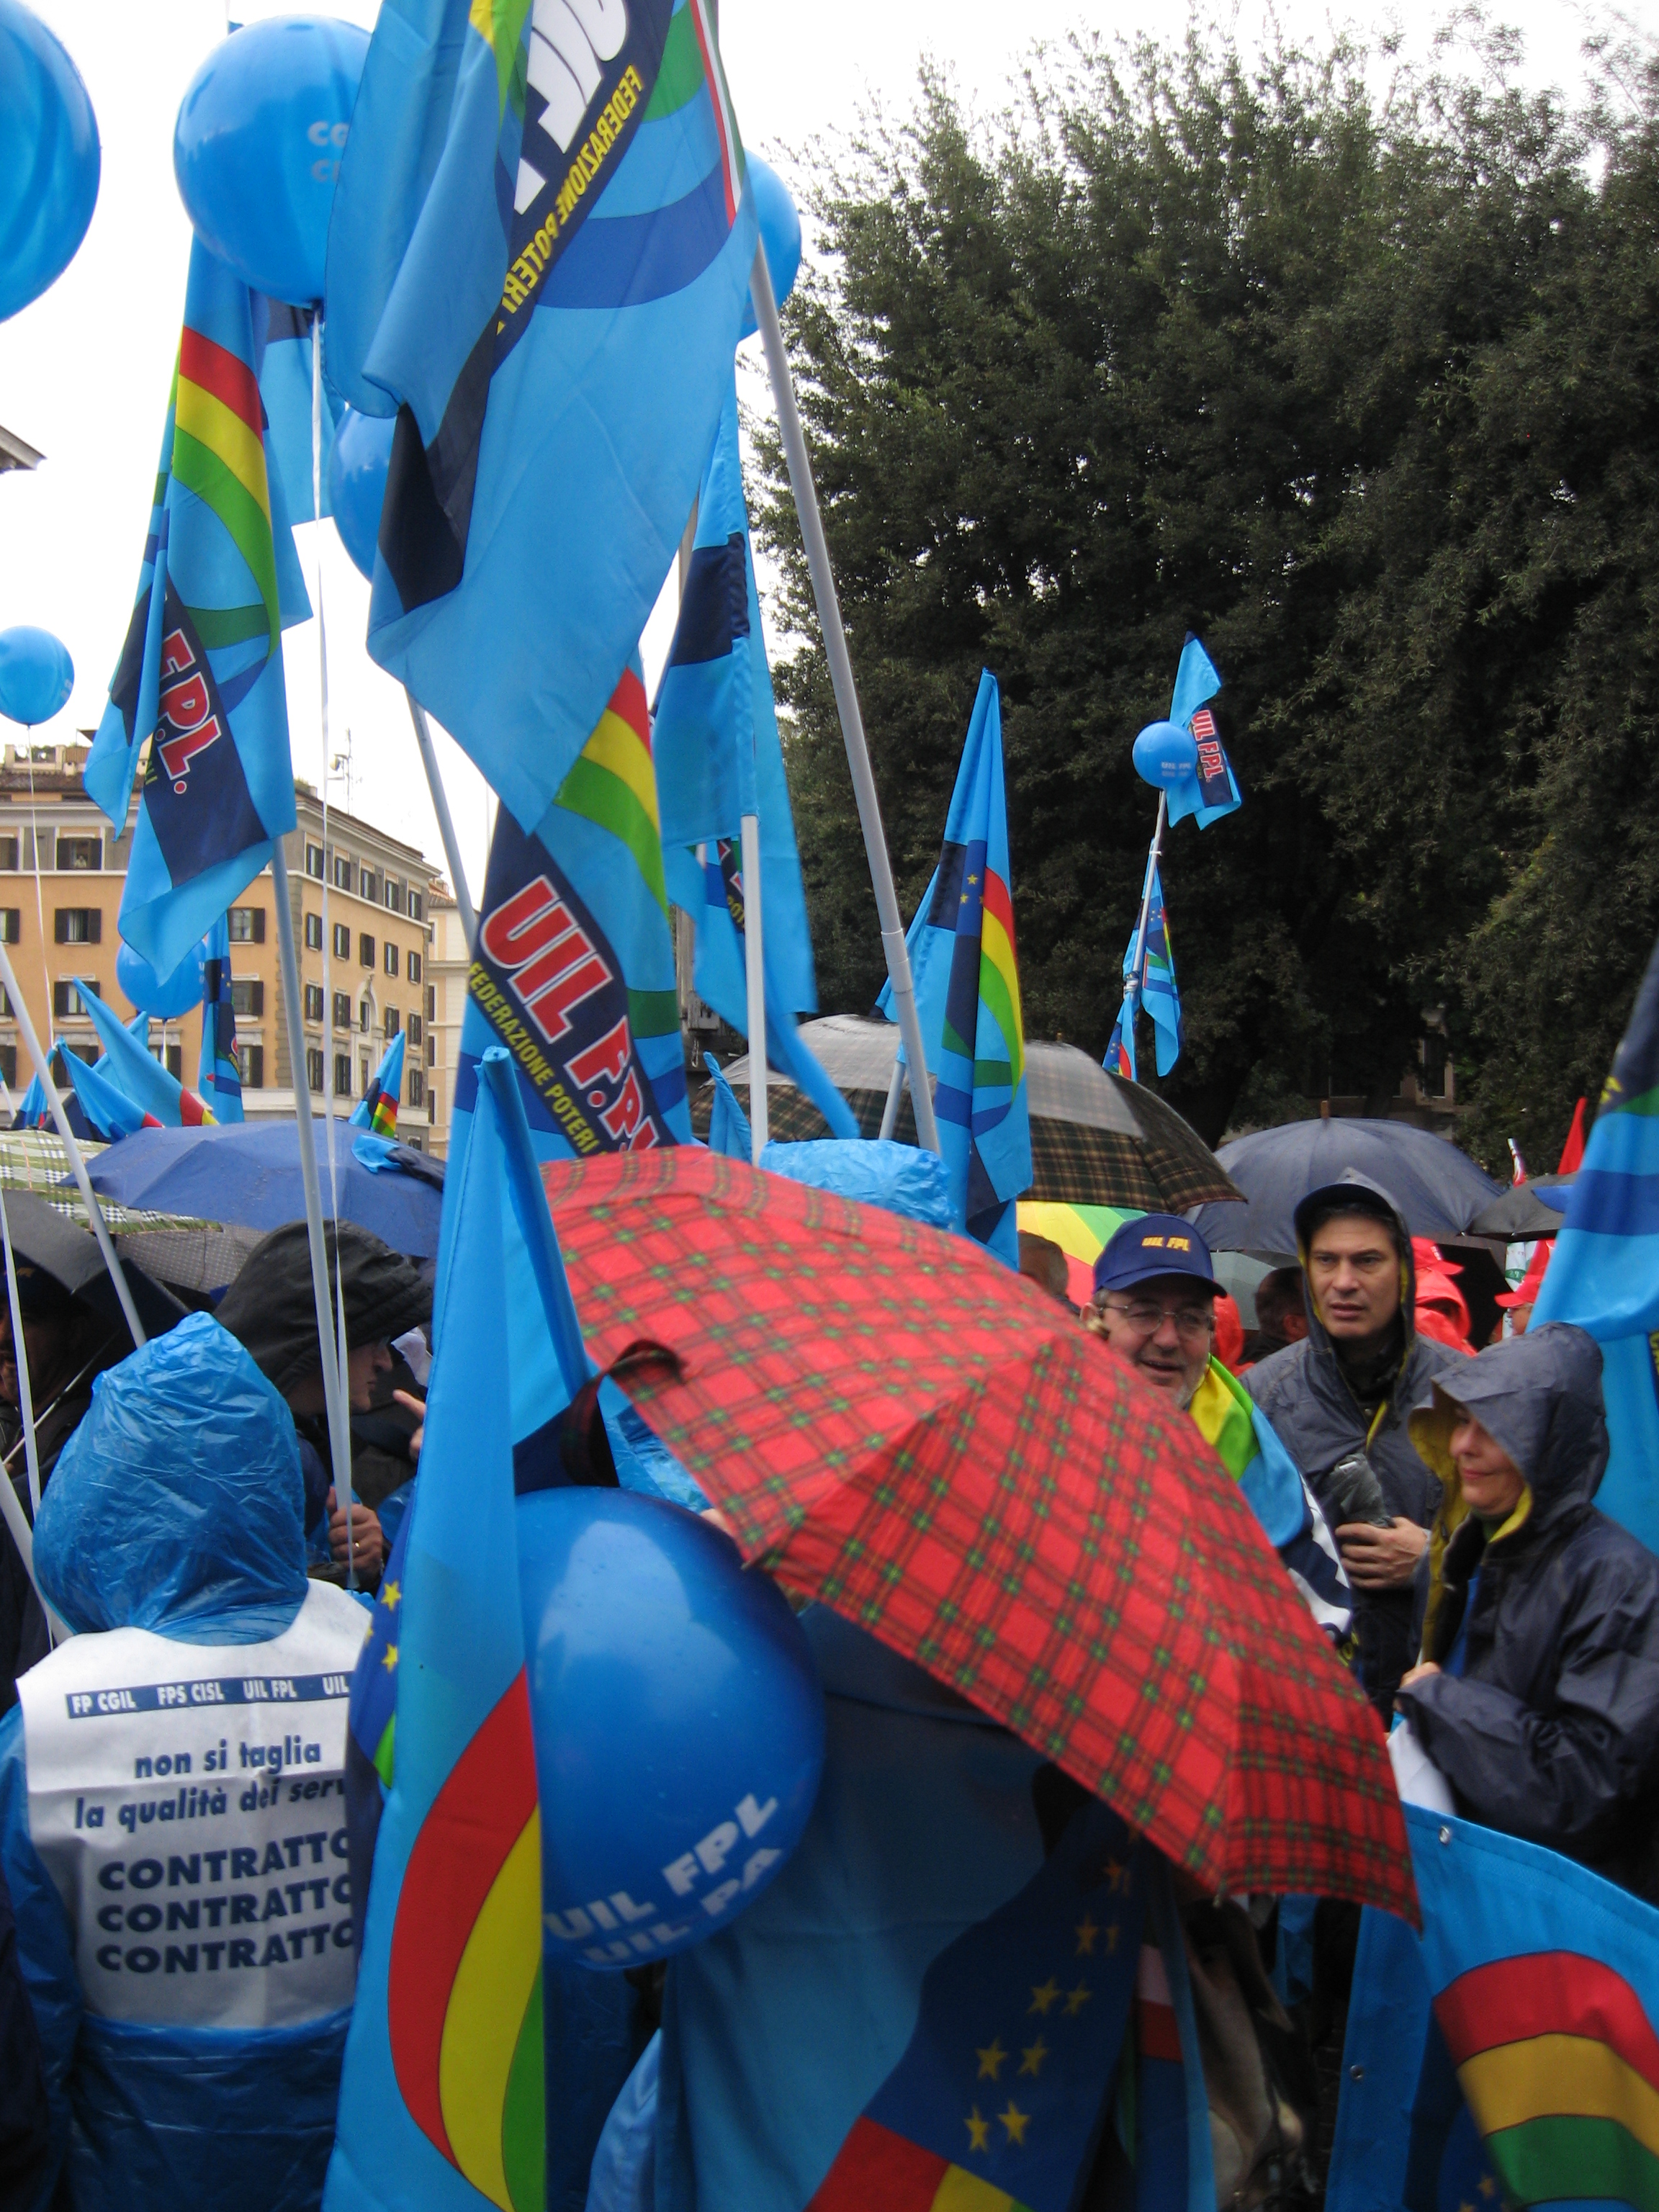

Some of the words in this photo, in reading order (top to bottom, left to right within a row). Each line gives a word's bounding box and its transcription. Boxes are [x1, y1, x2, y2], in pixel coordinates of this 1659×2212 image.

[1192, 709, 1215, 742] UIL
[480, 874, 613, 1044] UIL
[469, 961, 554, 1086] FEDERAZIONE
[544, 1083, 600, 1153] POTERI
[73, 1696, 92, 1714] FP
[96, 1691, 136, 1712] CGIL
[157, 1686, 186, 1705] FPS
[191, 1681, 225, 1702] CISL
[242, 1680, 268, 1699] UIL
[271, 1680, 297, 1699] FPL
[322, 1676, 349, 1695] UIL
[135, 1751, 192, 1778] non
[204, 1738, 227, 1771] si
[240, 1735, 321, 1774] taglia
[75, 1797, 104, 1829] la
[118, 1786, 228, 1833] qualità
[240, 1777, 281, 1812] dei
[543, 1891, 657, 1938] UIL
[662, 1793, 778, 1897] FPL
[583, 1923, 691, 1963] UIL
[700, 1848, 782, 1916] PA
